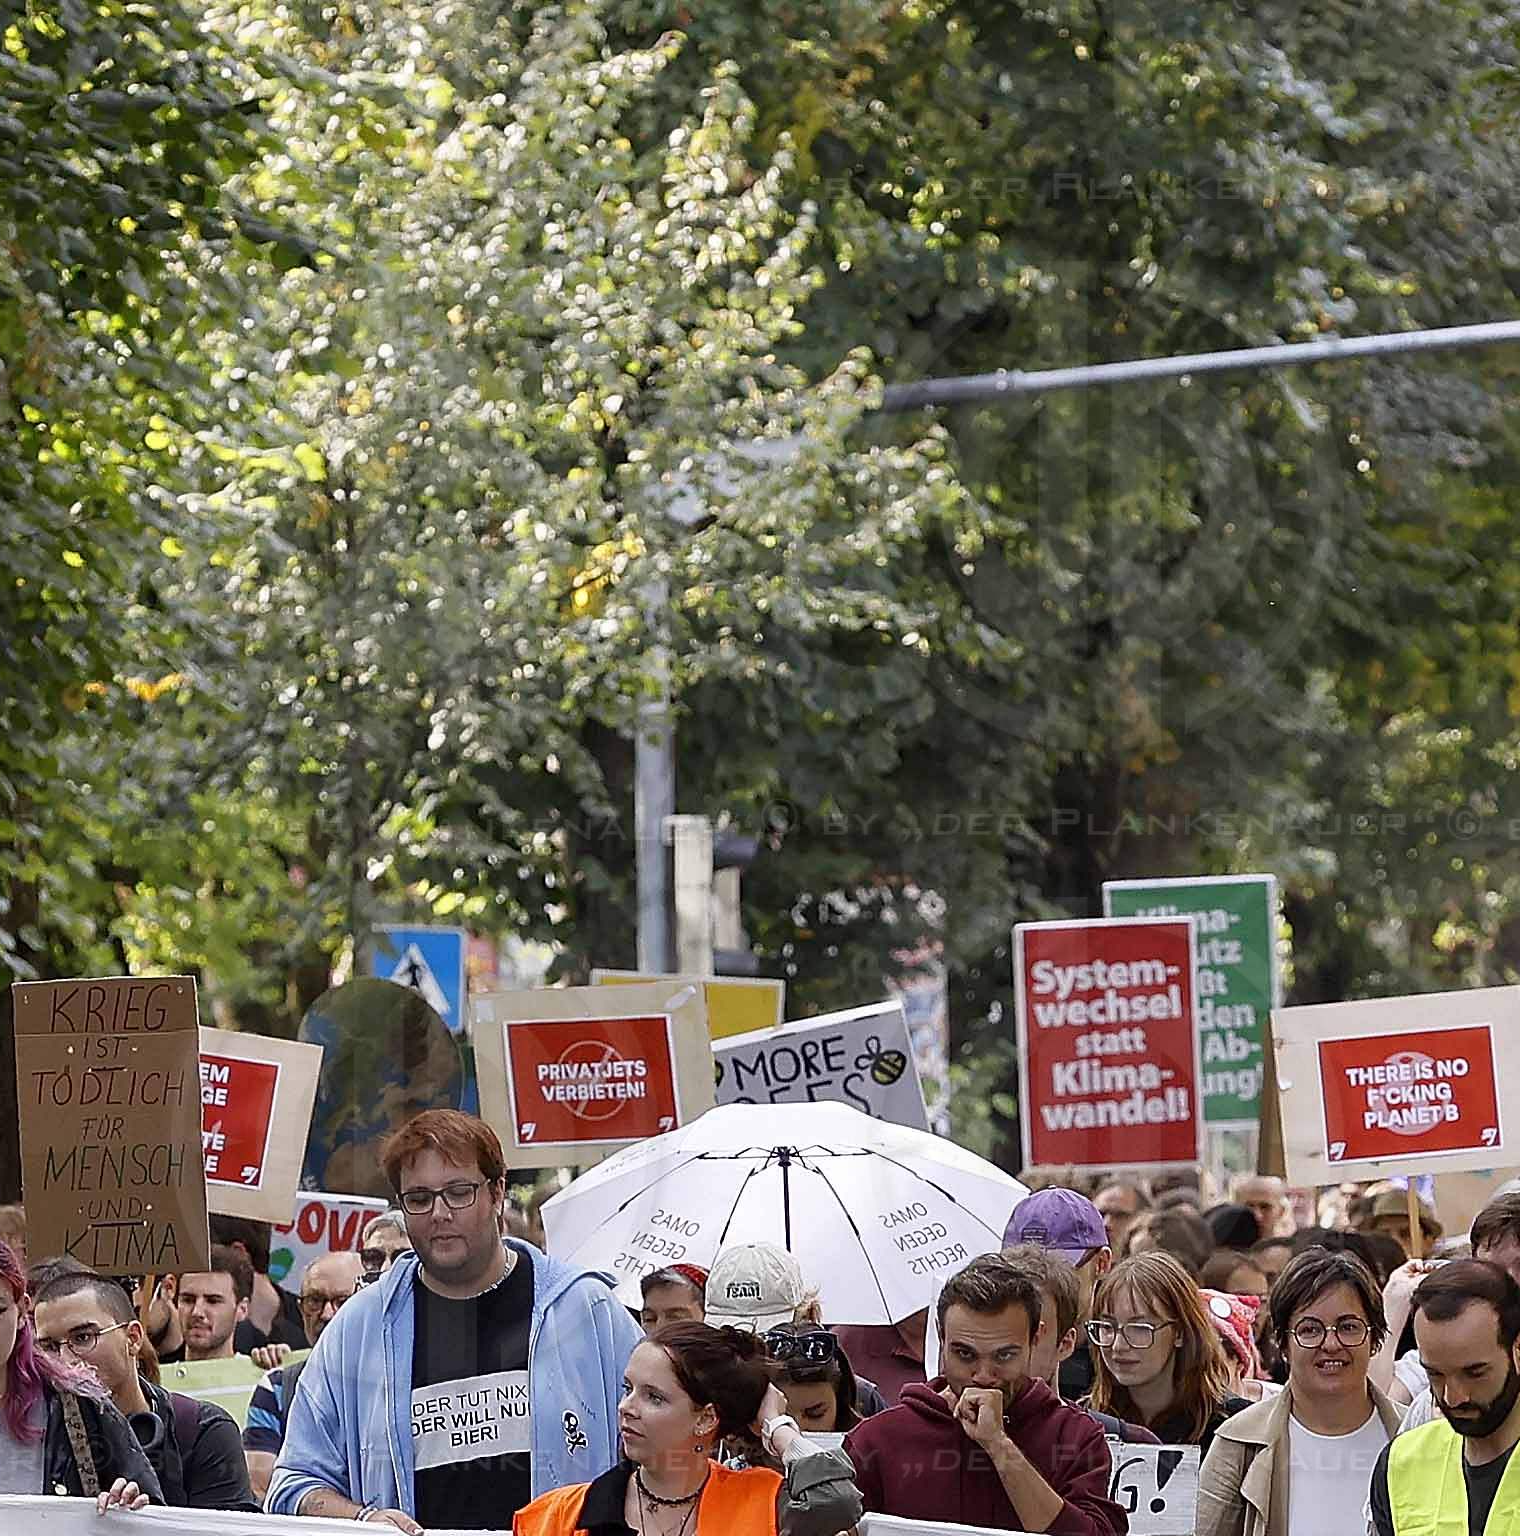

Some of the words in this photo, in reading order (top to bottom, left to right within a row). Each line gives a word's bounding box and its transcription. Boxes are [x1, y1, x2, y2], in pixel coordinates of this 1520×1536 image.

[1031, 959, 1181, 1000] System-
[51, 983, 171, 1033] KRIEG
[1032, 984, 1182, 1028] wechsel
[83, 1036, 130, 1060] IST
[1075, 1027, 1148, 1057] statt
[536, 1060, 647, 1081] PRIVATJETS
[731, 1035, 846, 1091] MORE
[1052, 1059, 1175, 1097] Klima-
[1345, 1064, 1411, 1088] THERE
[1414, 1061, 1434, 1081] IS
[1437, 1058, 1469, 1078] NO
[30, 1063, 185, 1107] TÖDLICH
[541, 1081, 646, 1102] VERBIETEN!
[1041, 1087, 1190, 1131] wandel!
[1363, 1106, 1442, 1130] PLANET
[1444, 1103, 1460, 1122] B
[81, 1114, 125, 1141] FÜR
[43, 1144, 185, 1192] MENSCH
[86, 1197, 144, 1221] UND
[275, 1200, 384, 1253] OV
[64, 1222, 182, 1268] KLIMA
[412, 1396, 451, 1418] DER
[456, 1389, 491, 1409] TUT
[496, 1383, 529, 1403] NIX
[451, 1409, 496, 1428] WILL
[501, 1401, 530, 1419] NU
[450, 1425, 499, 1447] BIER!
